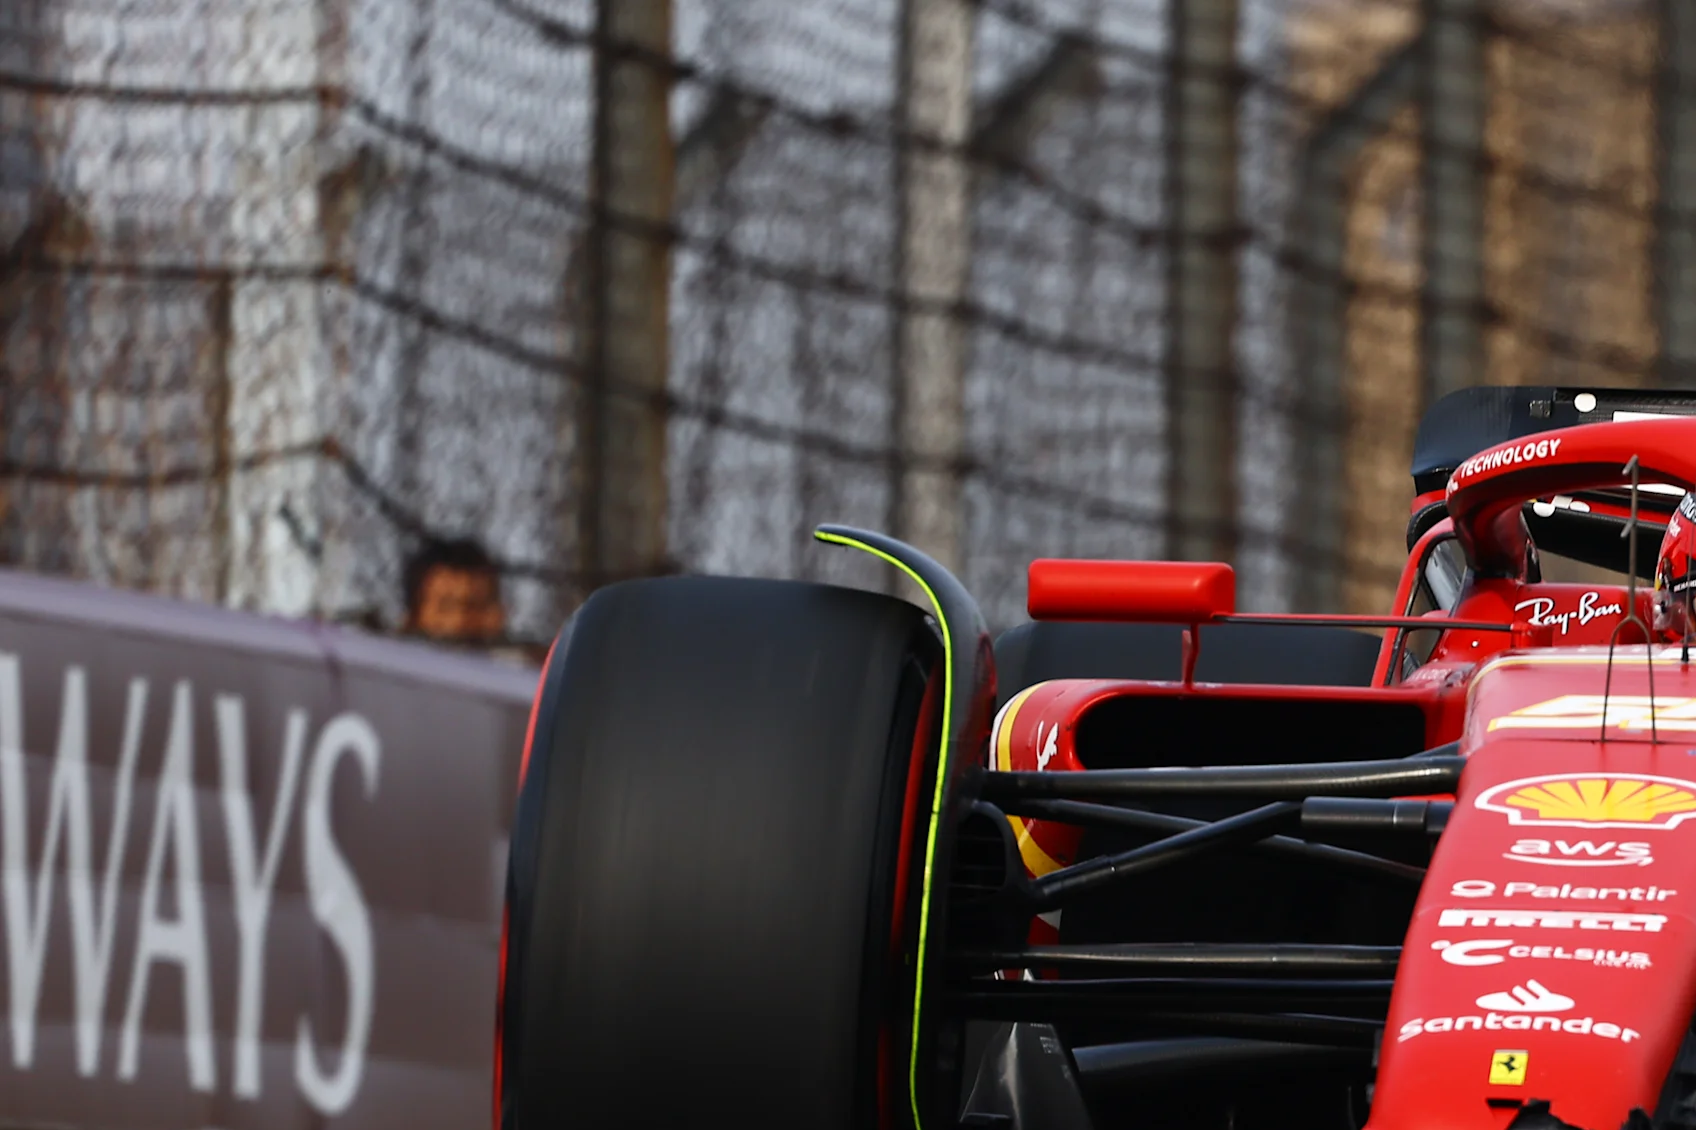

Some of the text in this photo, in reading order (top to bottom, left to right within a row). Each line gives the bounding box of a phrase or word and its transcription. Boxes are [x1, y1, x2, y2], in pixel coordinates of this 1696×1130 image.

[1460, 438, 1562, 478] TECHNOLOGY
[1514, 591, 1622, 635] Ray-Ban
[1510, 839, 1652, 858] aws
[0, 653, 381, 1115] WAYS
[1504, 881, 1678, 901] Palantir
[1438, 909, 1668, 932] PIRELLI
[1508, 945, 1651, 964] CELSIUS
